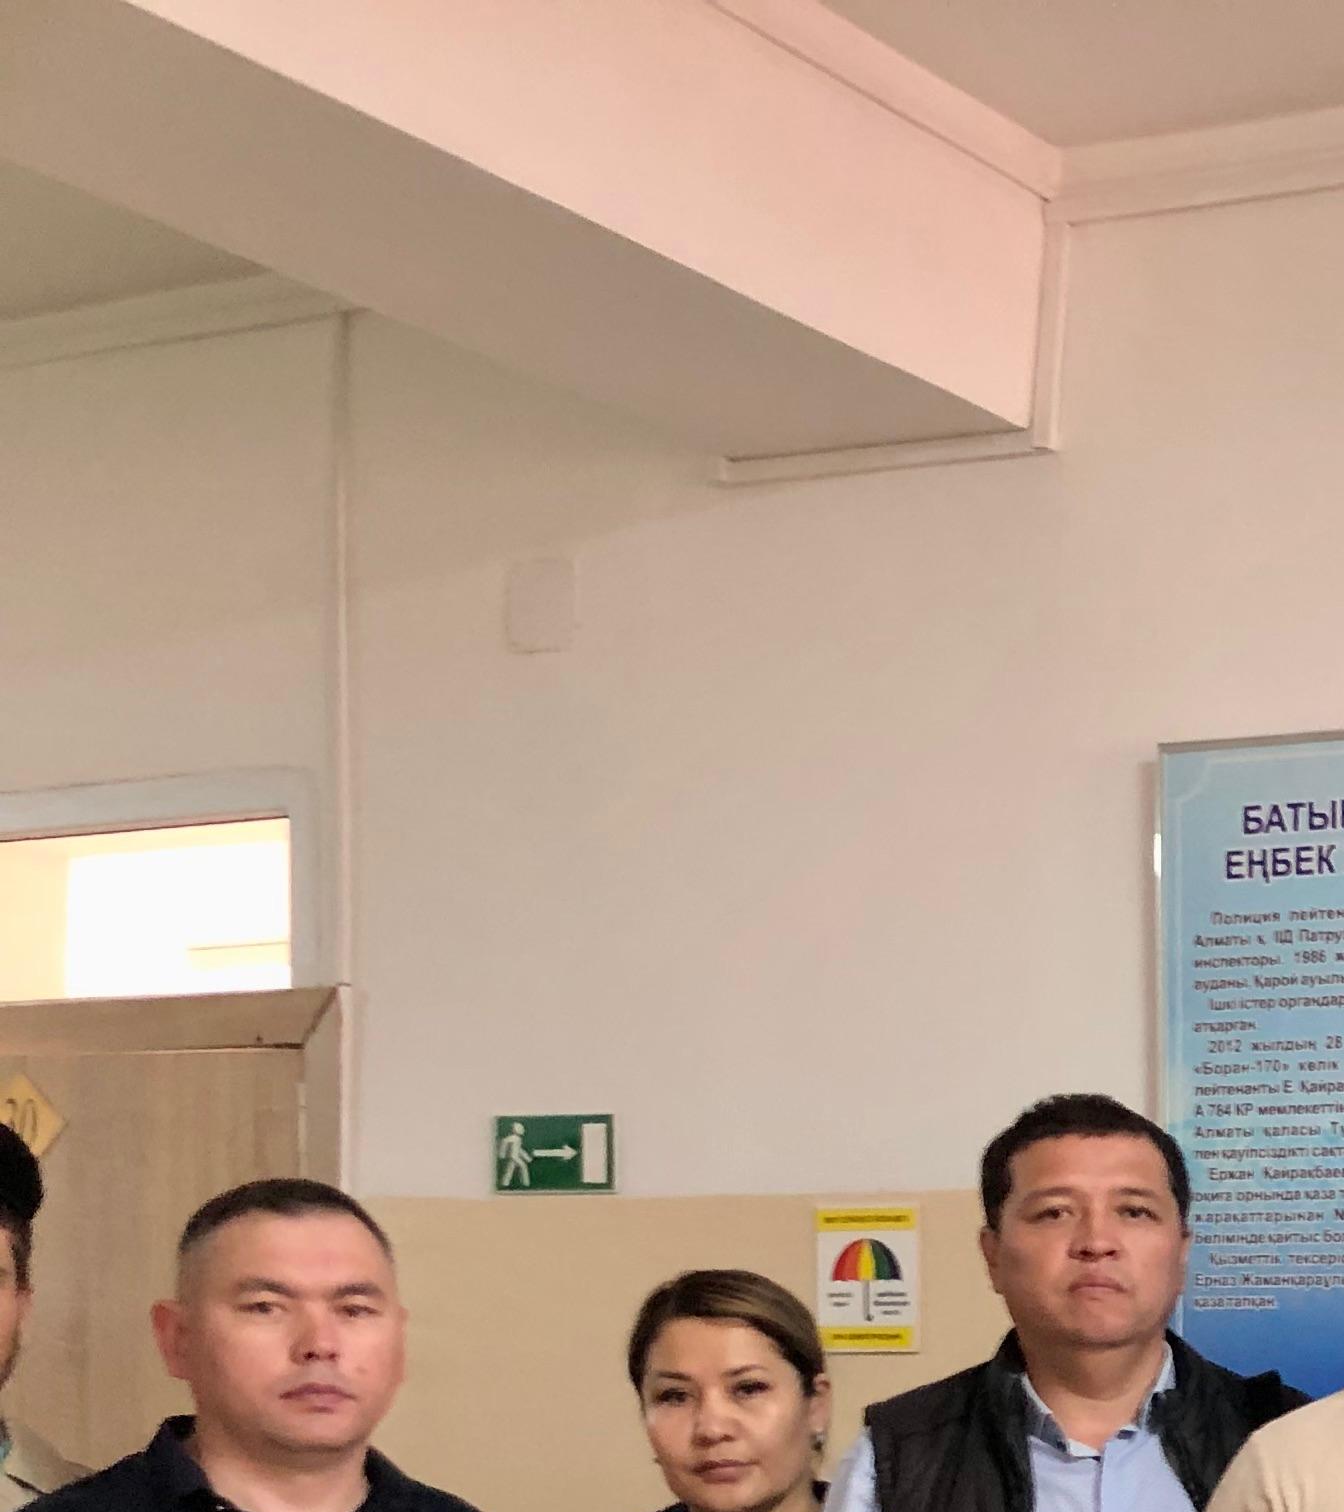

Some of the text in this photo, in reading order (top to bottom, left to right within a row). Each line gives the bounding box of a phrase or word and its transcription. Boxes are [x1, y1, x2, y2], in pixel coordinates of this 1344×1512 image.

[1225, 842, 1336, 883] ЕҢБЕК
[1210, 911, 1281, 926] Полиция
[1193, 933, 1252, 948] Алматы
[1194, 1081, 1280, 1097] лейтенанты
[1193, 1125, 1255, 1139] Алматы
[1208, 1167, 1255, 1183] Ержан
[1237, 1188, 1301, 1204] орнында
[1194, 1273, 1238, 1288] Ерназ
